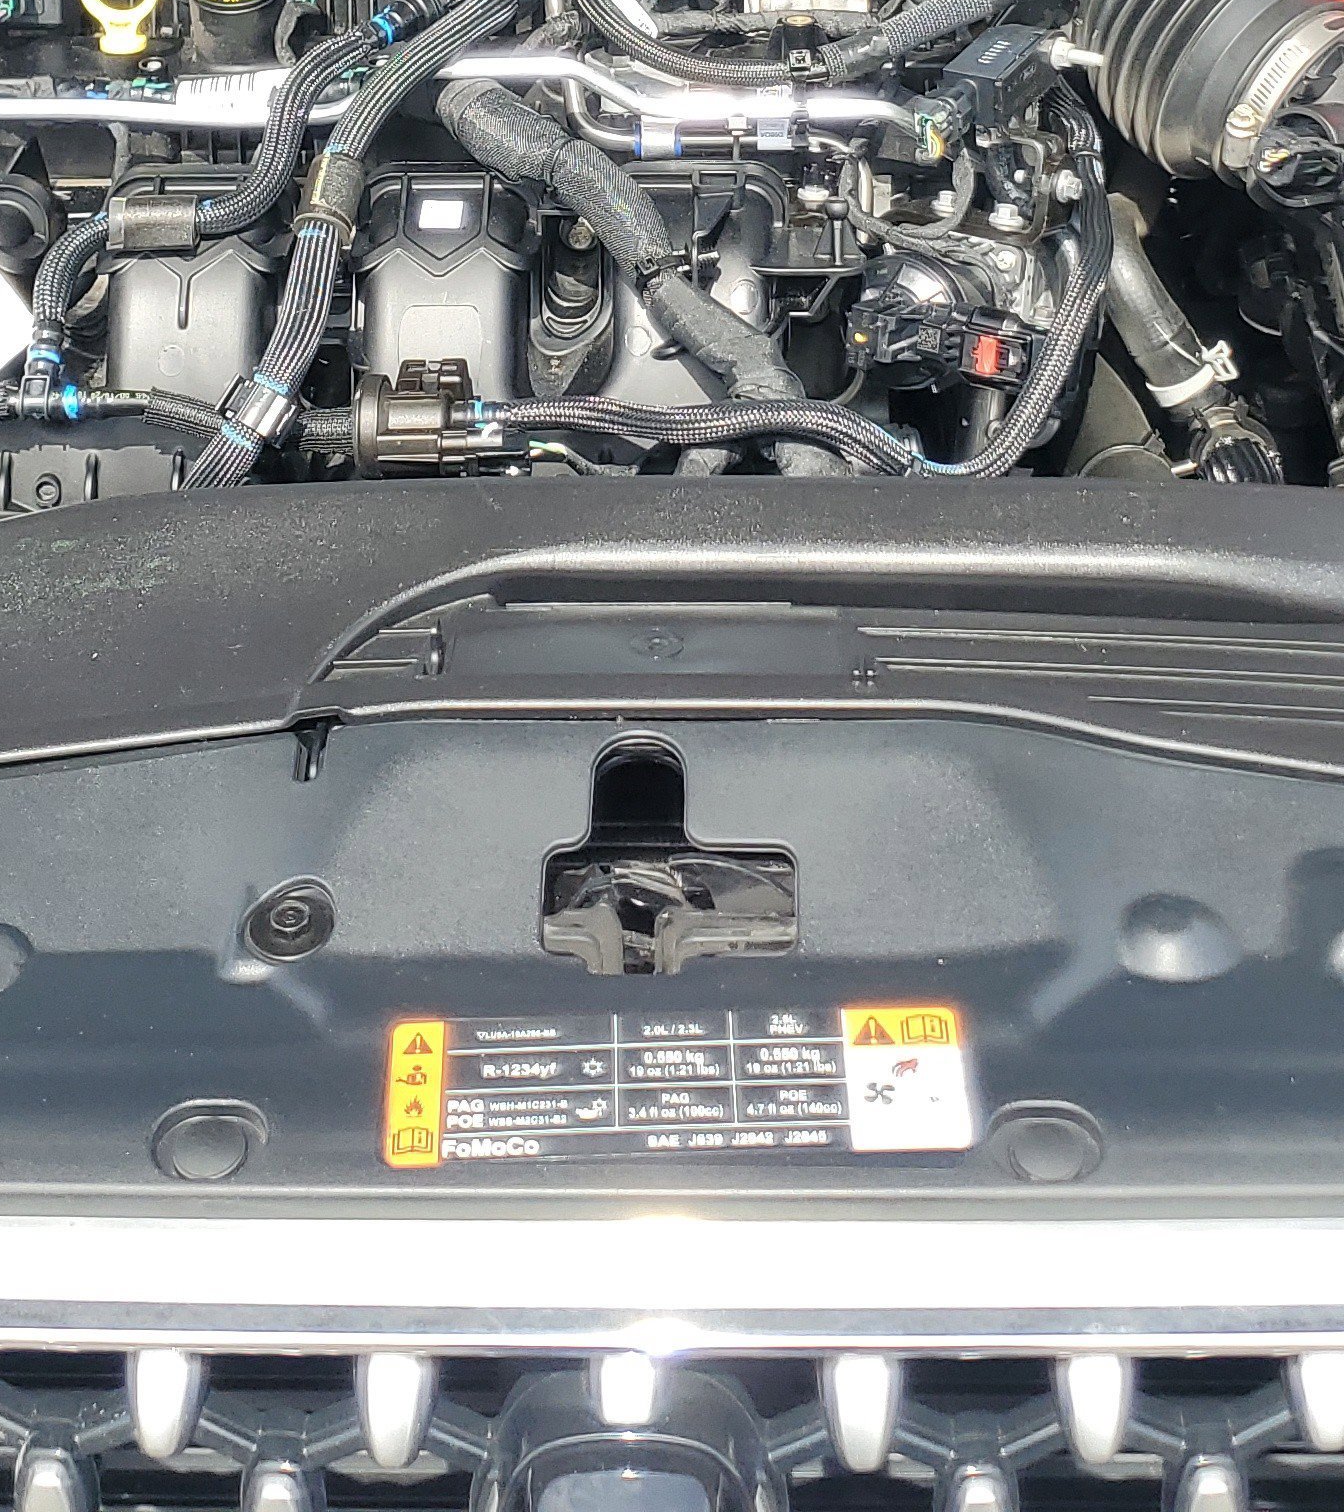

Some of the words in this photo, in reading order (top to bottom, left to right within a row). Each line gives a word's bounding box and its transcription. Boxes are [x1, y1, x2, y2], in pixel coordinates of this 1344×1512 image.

[685, 1049, 705, 1065] kg
[801, 1046, 820, 1062] kg
[483, 1062, 557, 1079] R-1234yf
[661, 1092, 690, 1104] PAG
[779, 1089, 807, 1101] POE
[447, 1099, 485, 1113] PAG
[628, 1106, 647, 1119] 3.4
[746, 1103, 765, 1116] 4.7
[446, 1113, 485, 1128] POE
[441, 1136, 540, 1159] FoMoCo
